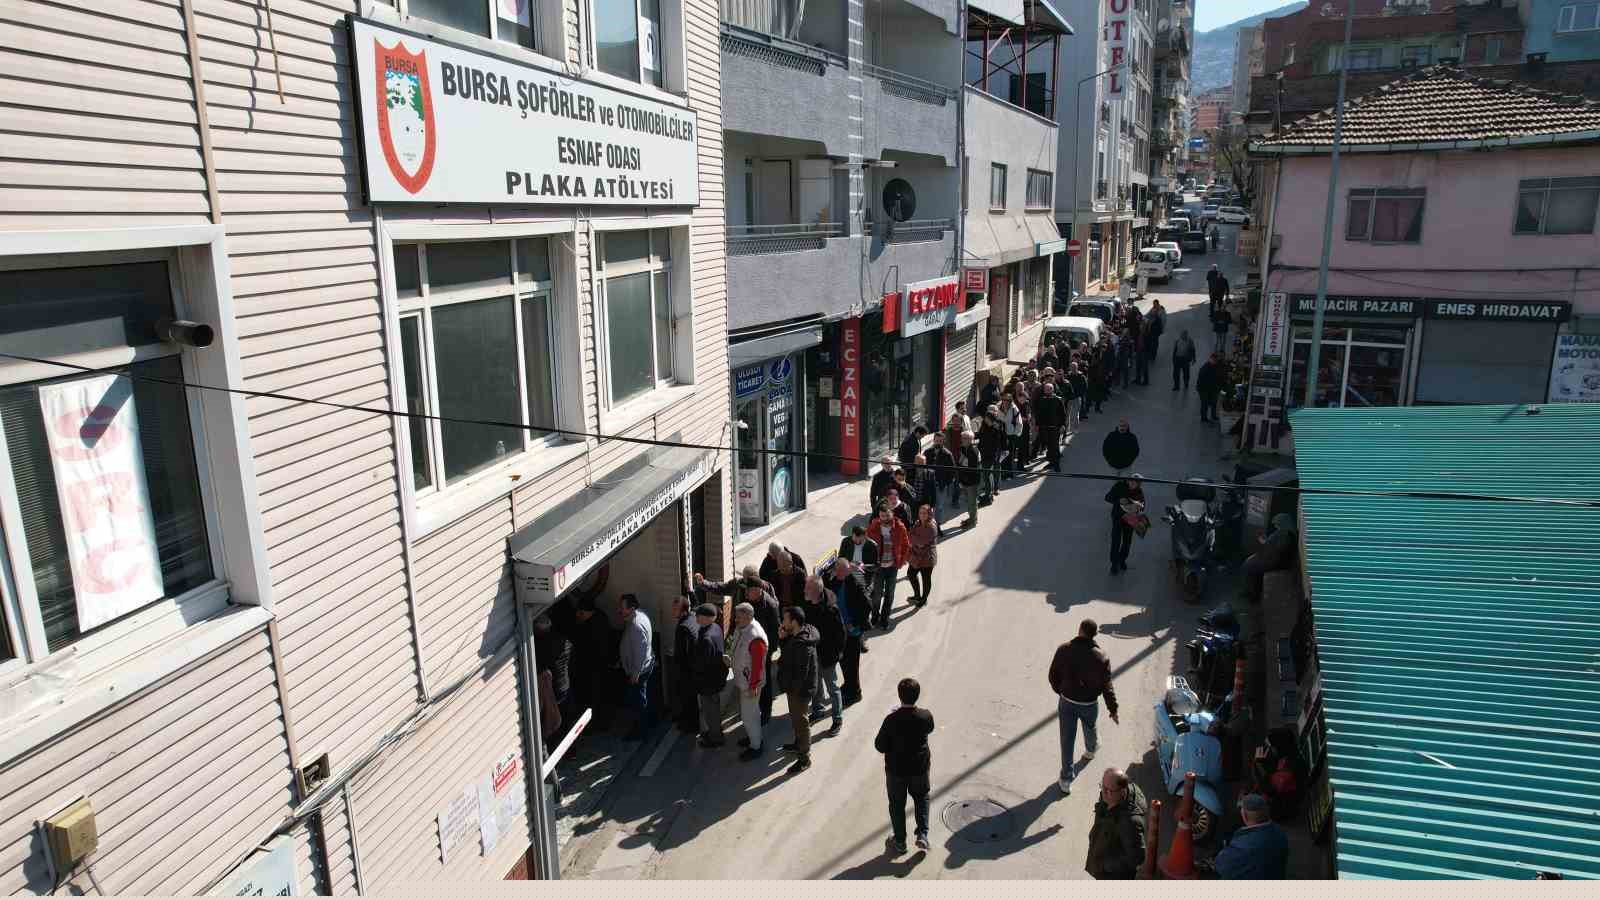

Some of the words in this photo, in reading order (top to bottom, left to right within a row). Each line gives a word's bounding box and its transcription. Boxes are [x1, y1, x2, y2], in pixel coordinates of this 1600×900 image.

[1110, 0, 1128, 93] OTEL
[384, 55, 418, 75] BURSA
[441, 61, 512, 107] BURSA
[517, 79, 596, 124] ŞOFÖRLER
[600, 106, 614, 126] ve
[617, 105, 694, 142] OTOMOBİLCİLER
[558, 136, 603, 167] ESNAF
[606, 147, 641, 171] ODASI
[506, 171, 586, 198] PLAKA
[594, 177, 674, 201] ATÖLYESİ
[1363, 301, 1414, 313] PAZARI
[1437, 303, 1476, 316] ENES
[1482, 304, 1562, 318] HIRDAVAT
[844, 329, 857, 437] ECZANE
[610, 520, 639, 549] PLAKA
